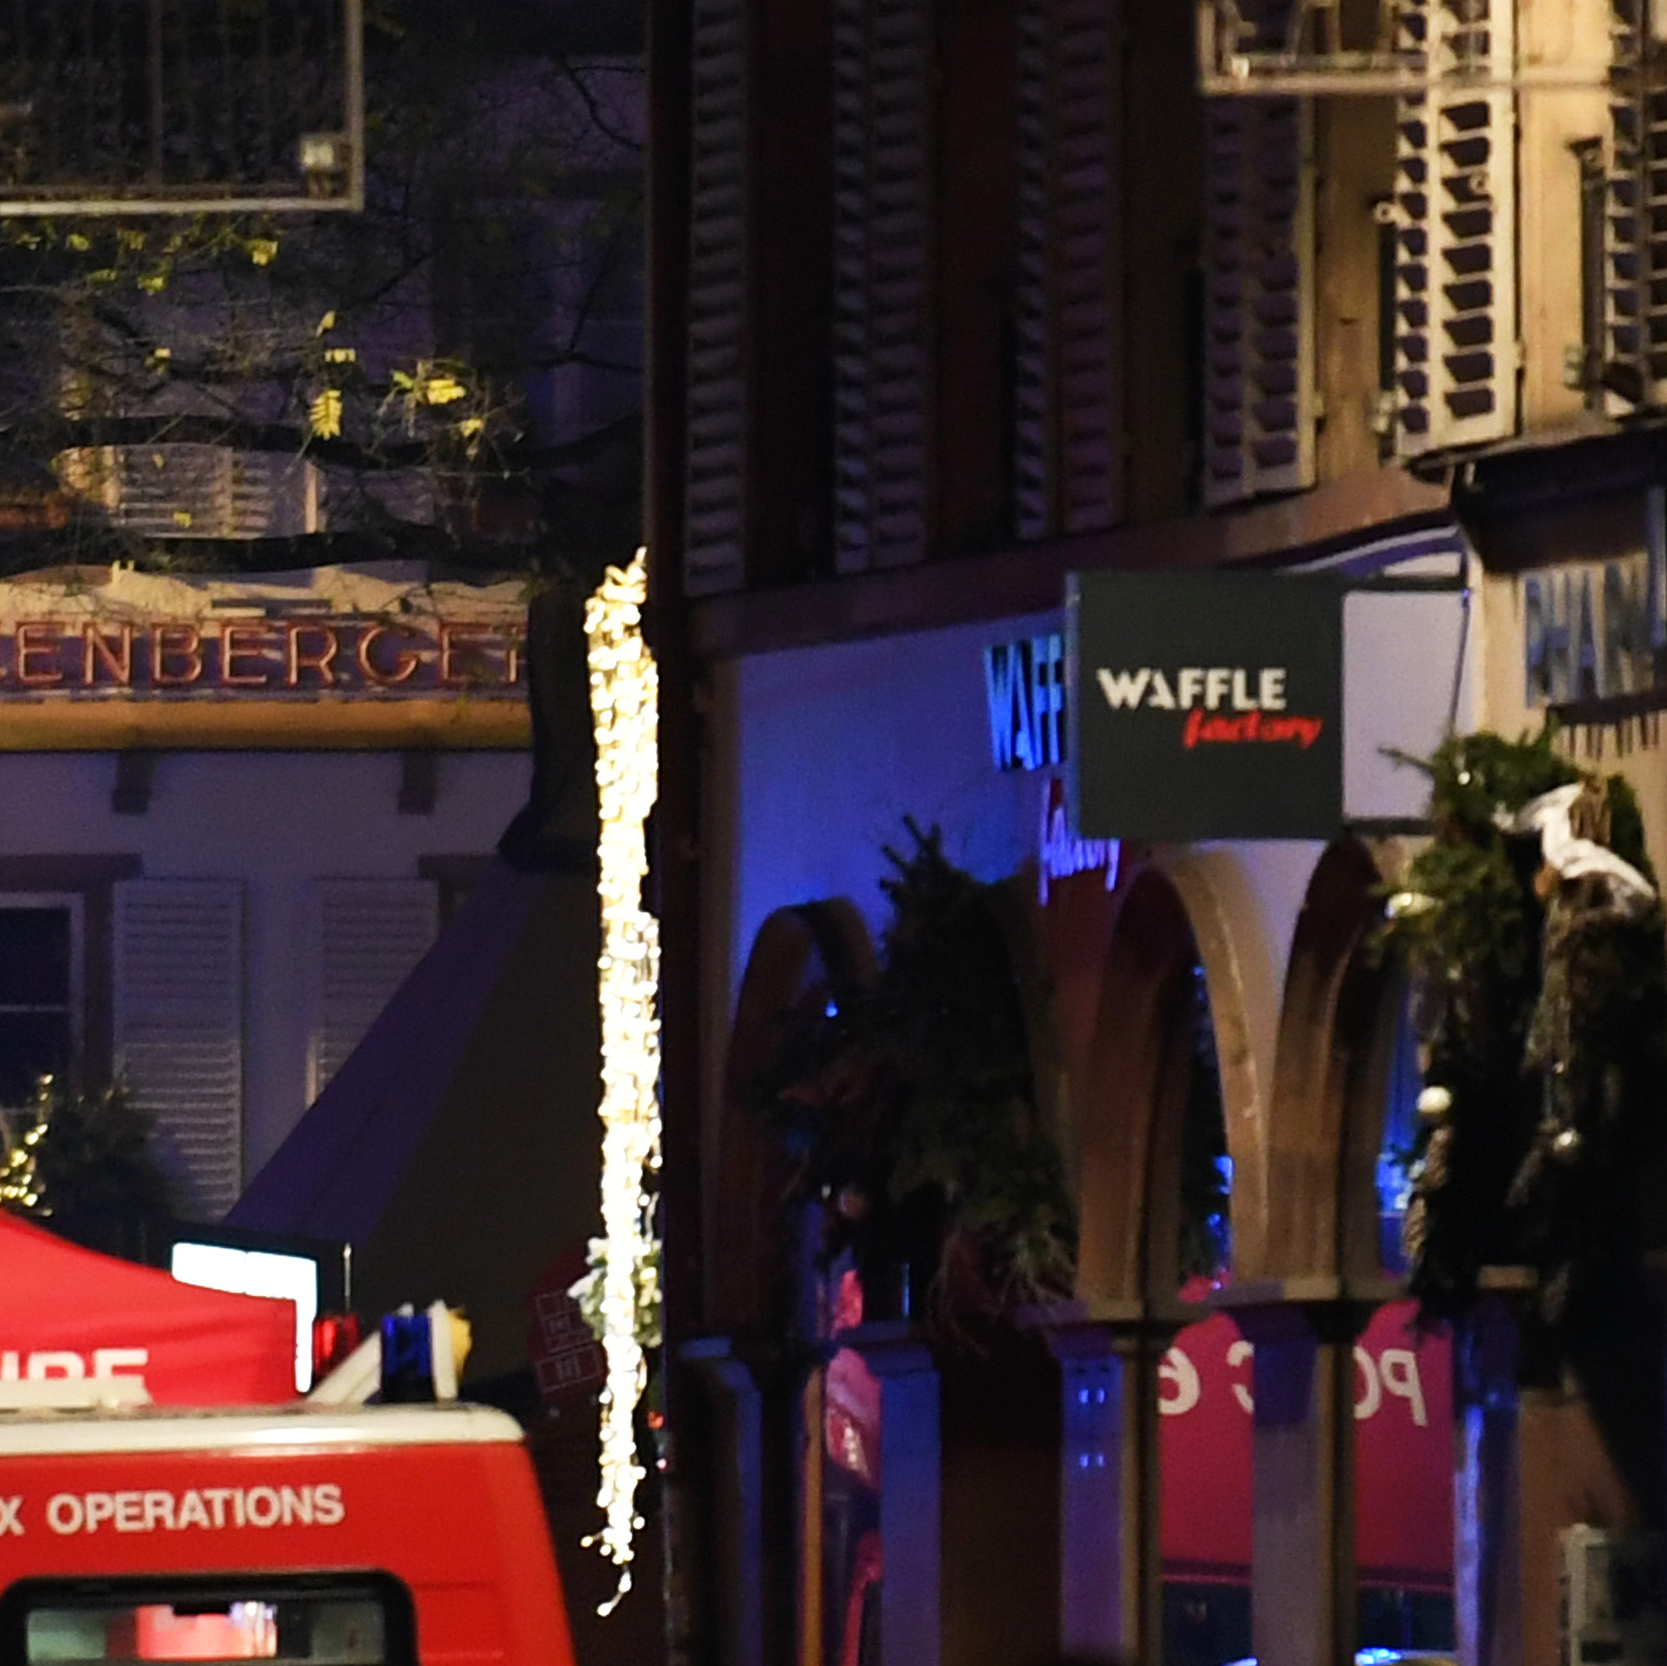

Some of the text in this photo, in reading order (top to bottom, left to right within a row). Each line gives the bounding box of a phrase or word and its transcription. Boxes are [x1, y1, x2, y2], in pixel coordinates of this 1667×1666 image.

[1095, 666, 1289, 711] WAFFLE
[1182, 707, 1324, 749] factory
[45, 1483, 346, 1536] OPERATIONS
